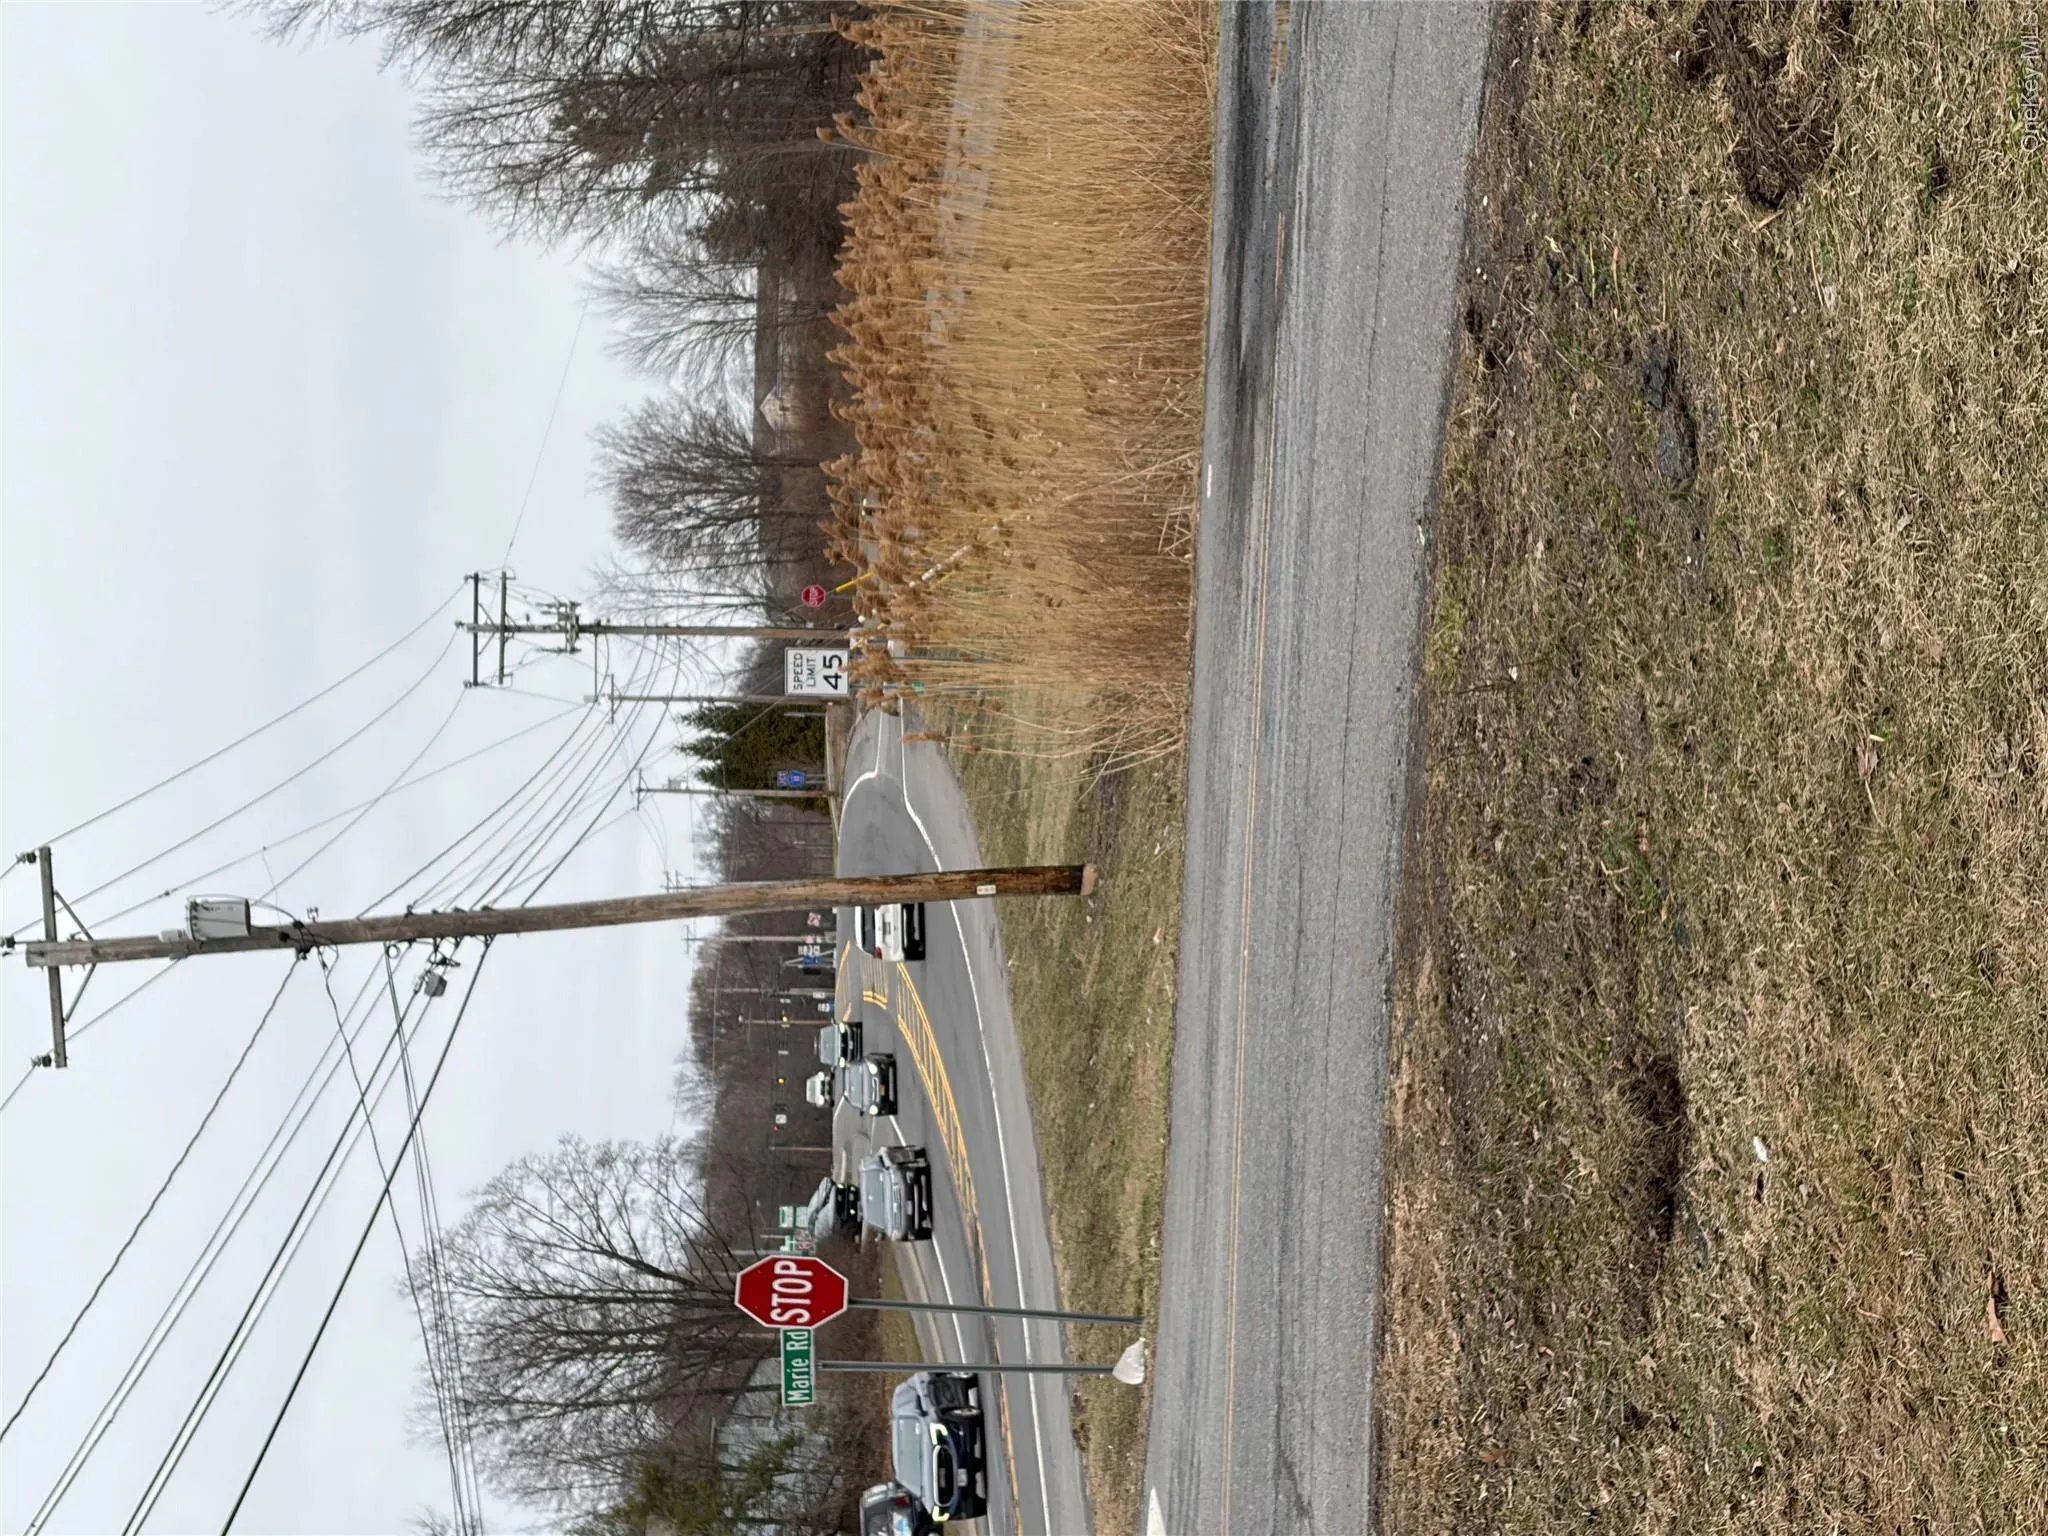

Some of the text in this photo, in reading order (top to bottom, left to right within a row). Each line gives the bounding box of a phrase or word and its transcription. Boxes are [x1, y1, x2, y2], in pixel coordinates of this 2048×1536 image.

[809, 587, 818, 606] STOP
[793, 652, 803, 690] SPEED
[806, 657, 816, 688] LIMIT
[823, 655, 842, 690] 45
[770, 1260, 813, 1323] STOP
[785, 1331, 810, 1401] Marie Rd
